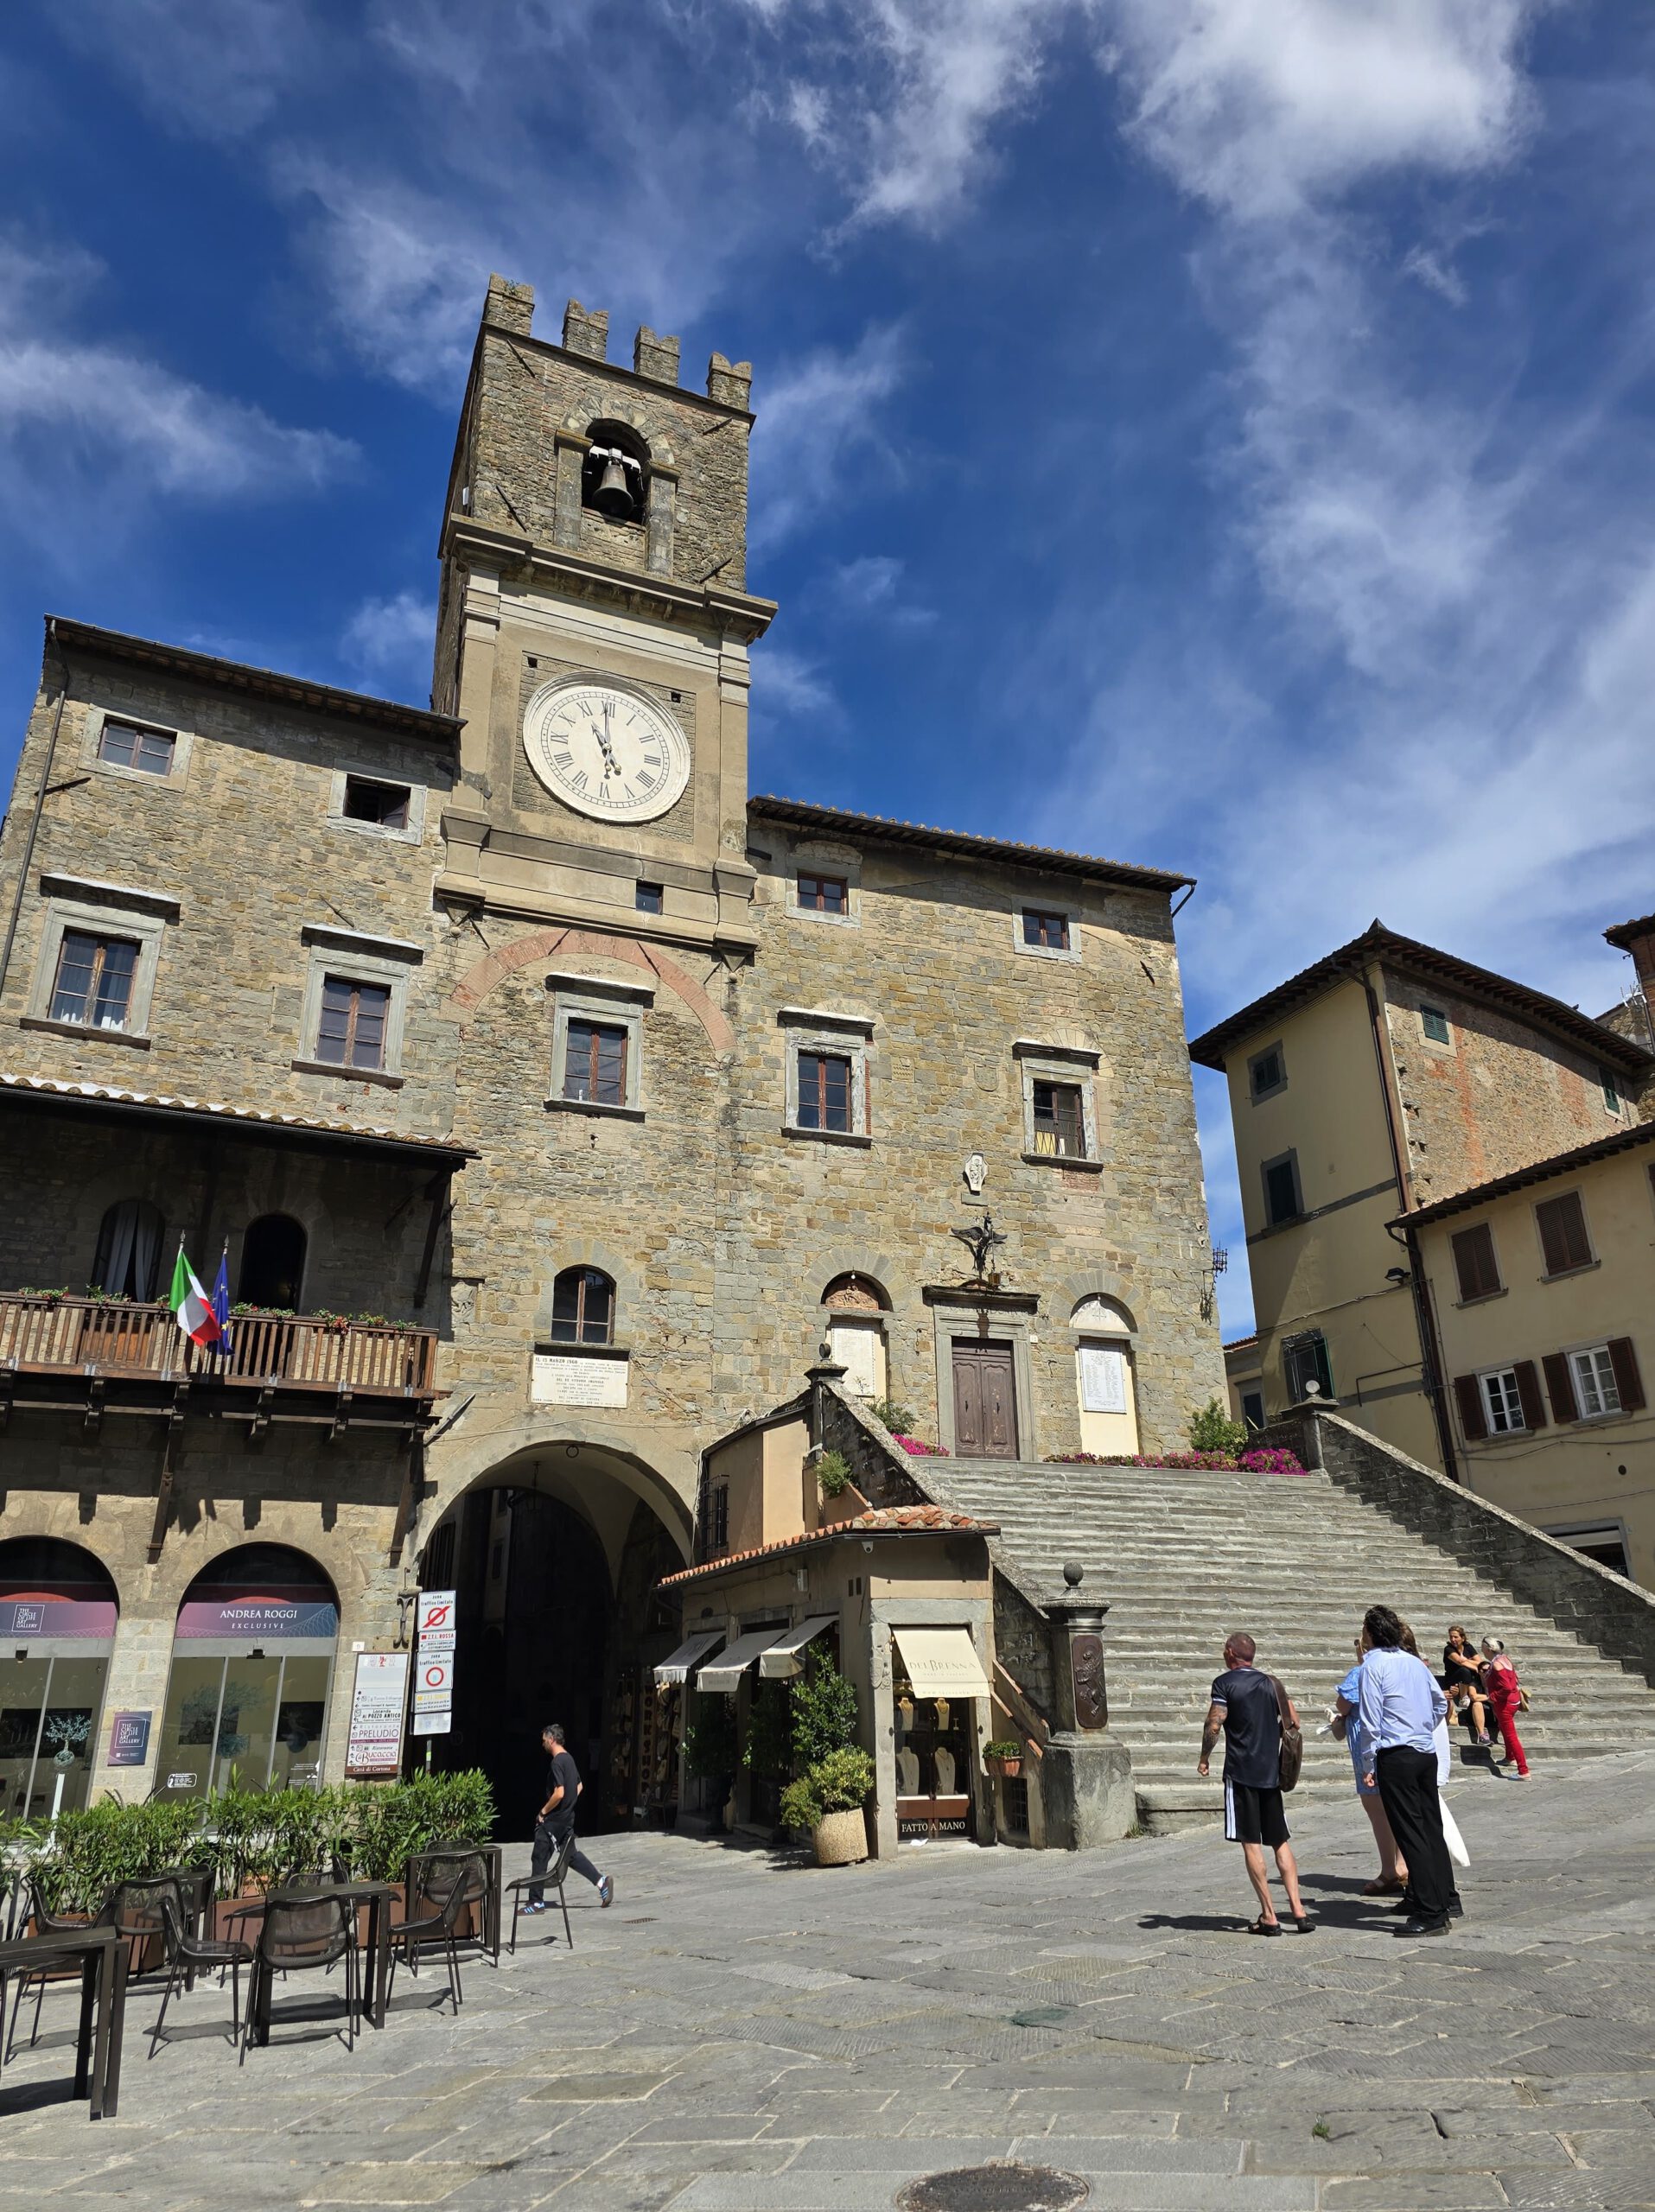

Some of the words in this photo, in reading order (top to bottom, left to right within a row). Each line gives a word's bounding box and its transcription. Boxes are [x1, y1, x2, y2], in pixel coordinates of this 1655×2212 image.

[220, 1610, 261, 1618] ANDREA
[264, 1610, 297, 1618] ROGGI
[359, 1729, 399, 1738] PRELUDIO
[901, 1822, 928, 1833] FATTO
[930, 1822, 938, 1831] A
[939, 1821, 965, 1831] MANO
